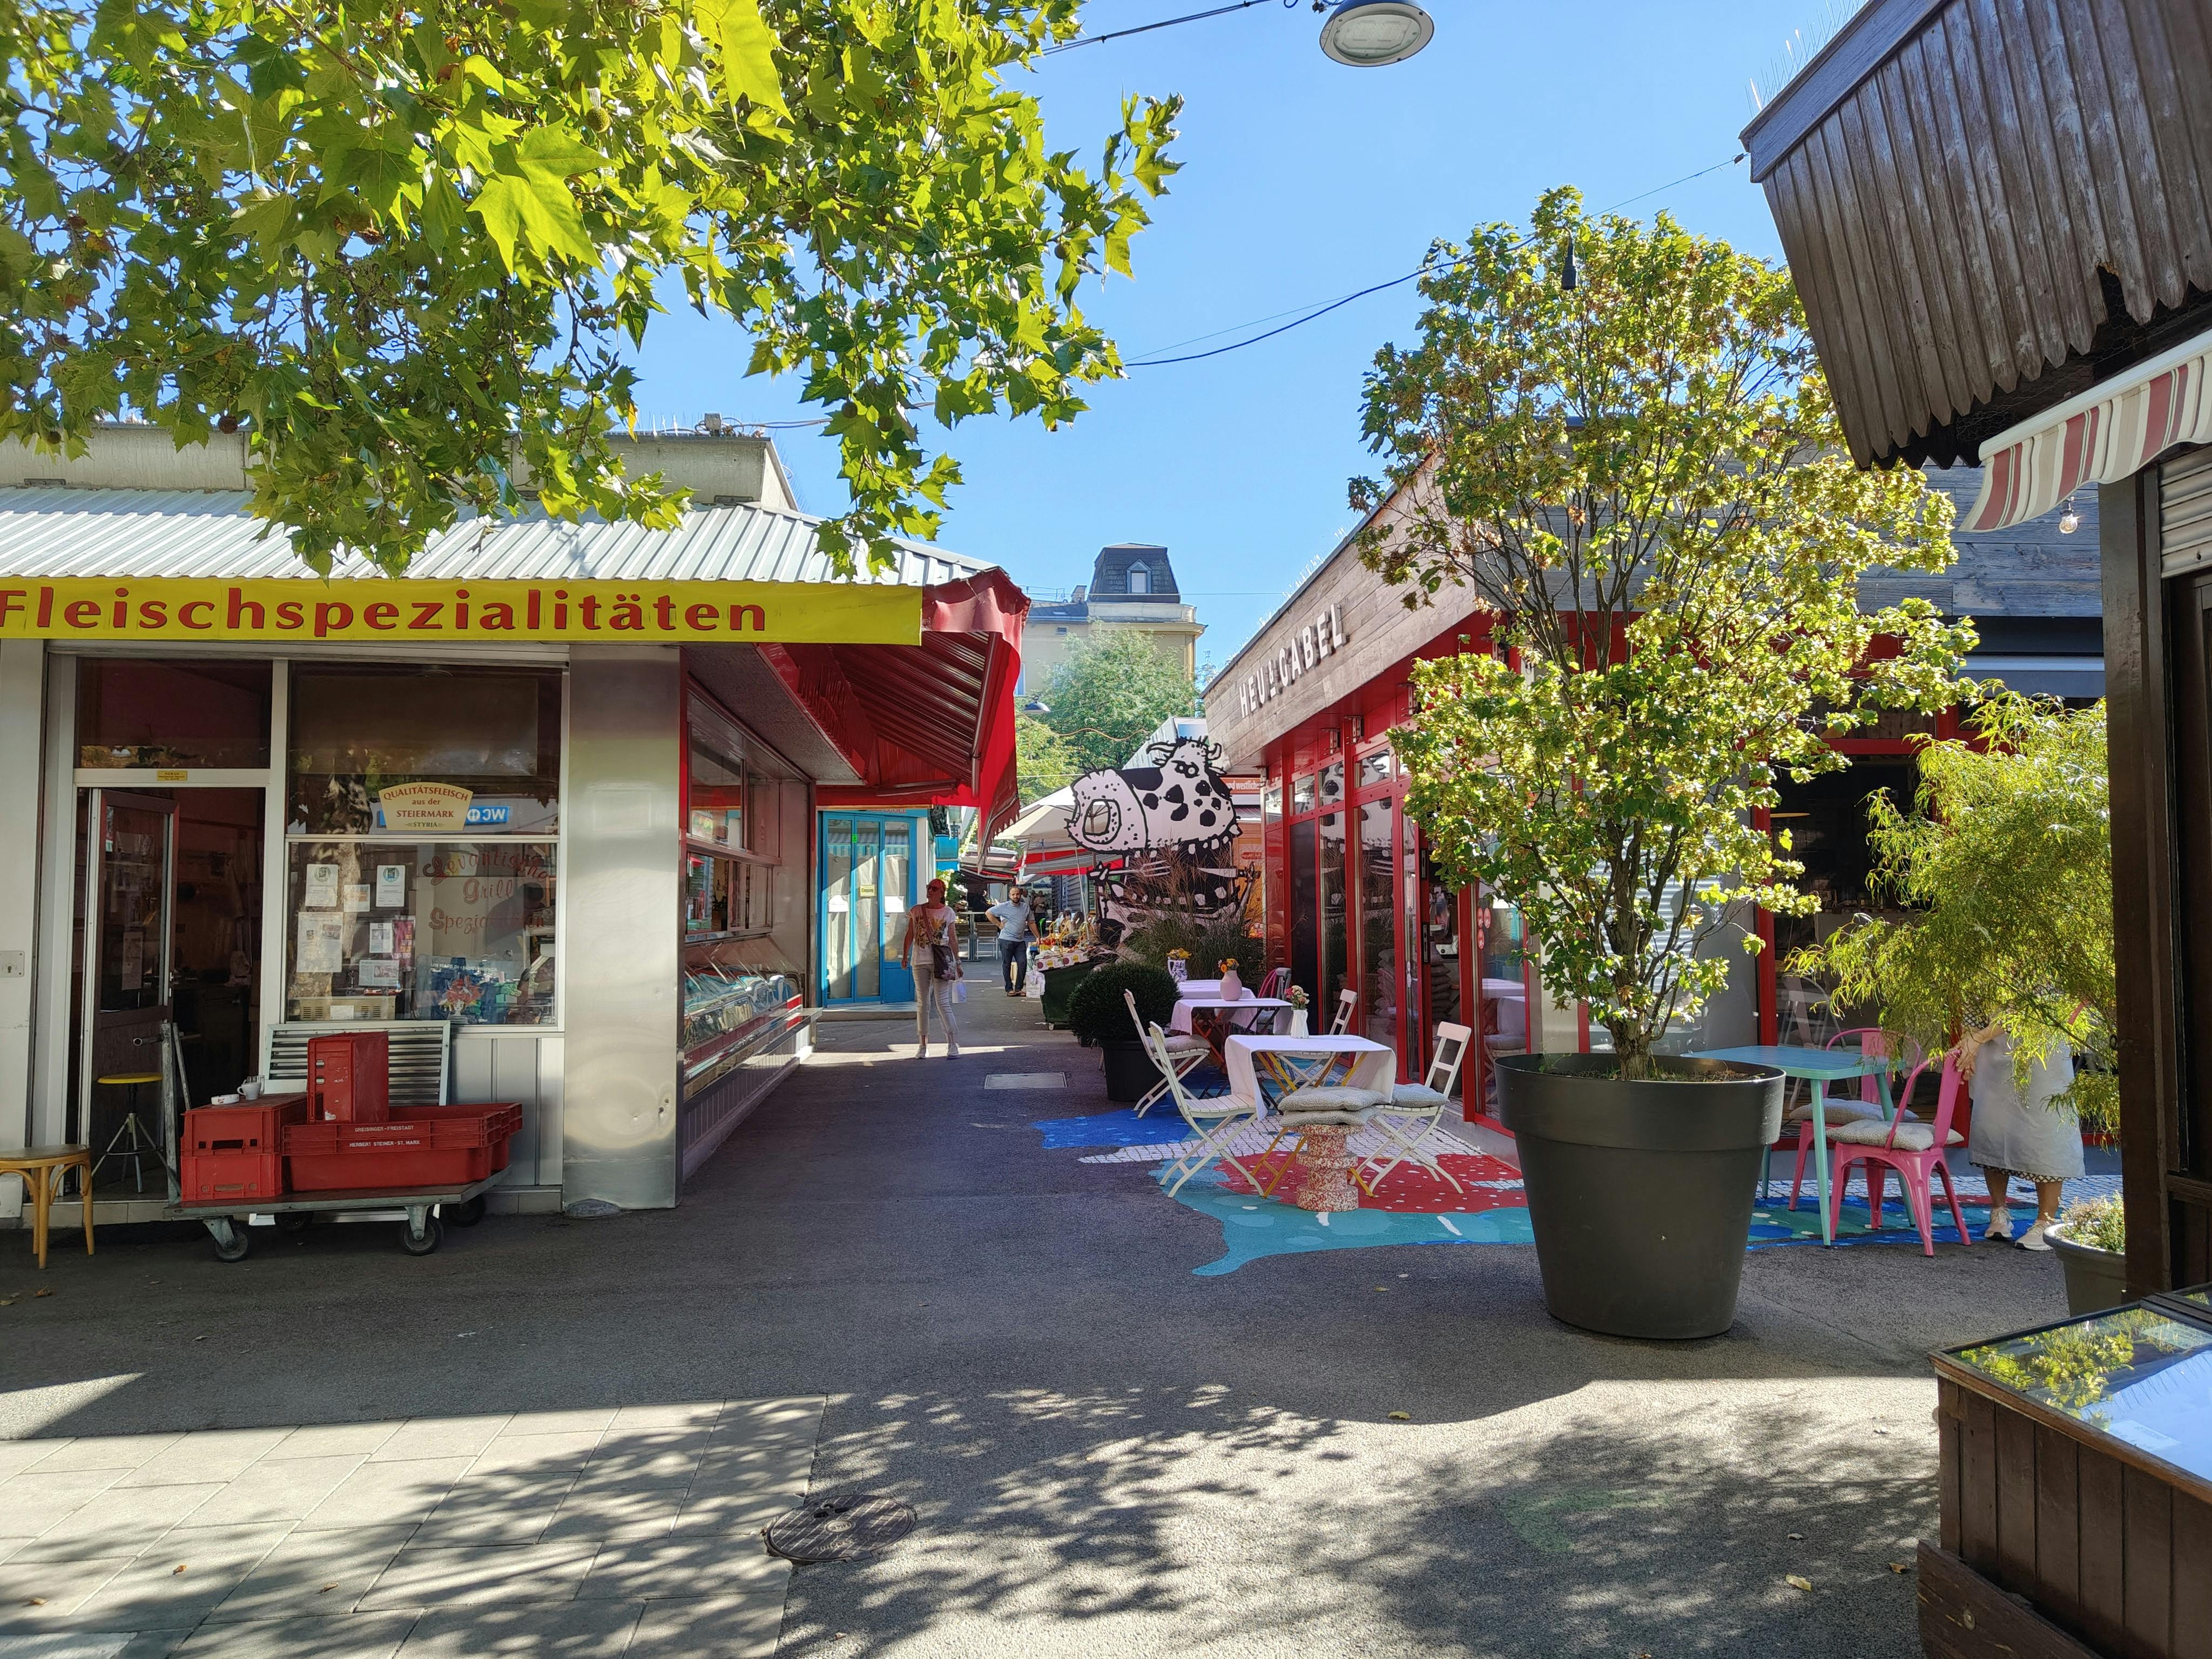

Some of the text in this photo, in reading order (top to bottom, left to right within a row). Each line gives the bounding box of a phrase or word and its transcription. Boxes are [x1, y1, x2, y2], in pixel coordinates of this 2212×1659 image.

[0, 586, 765, 638] Fleischspezialitäten
[383, 785, 468, 801] QUALITÄTSFLEISCH
[396, 810, 454, 818] STEIERMARK
[463, 878, 514, 905] Grill
